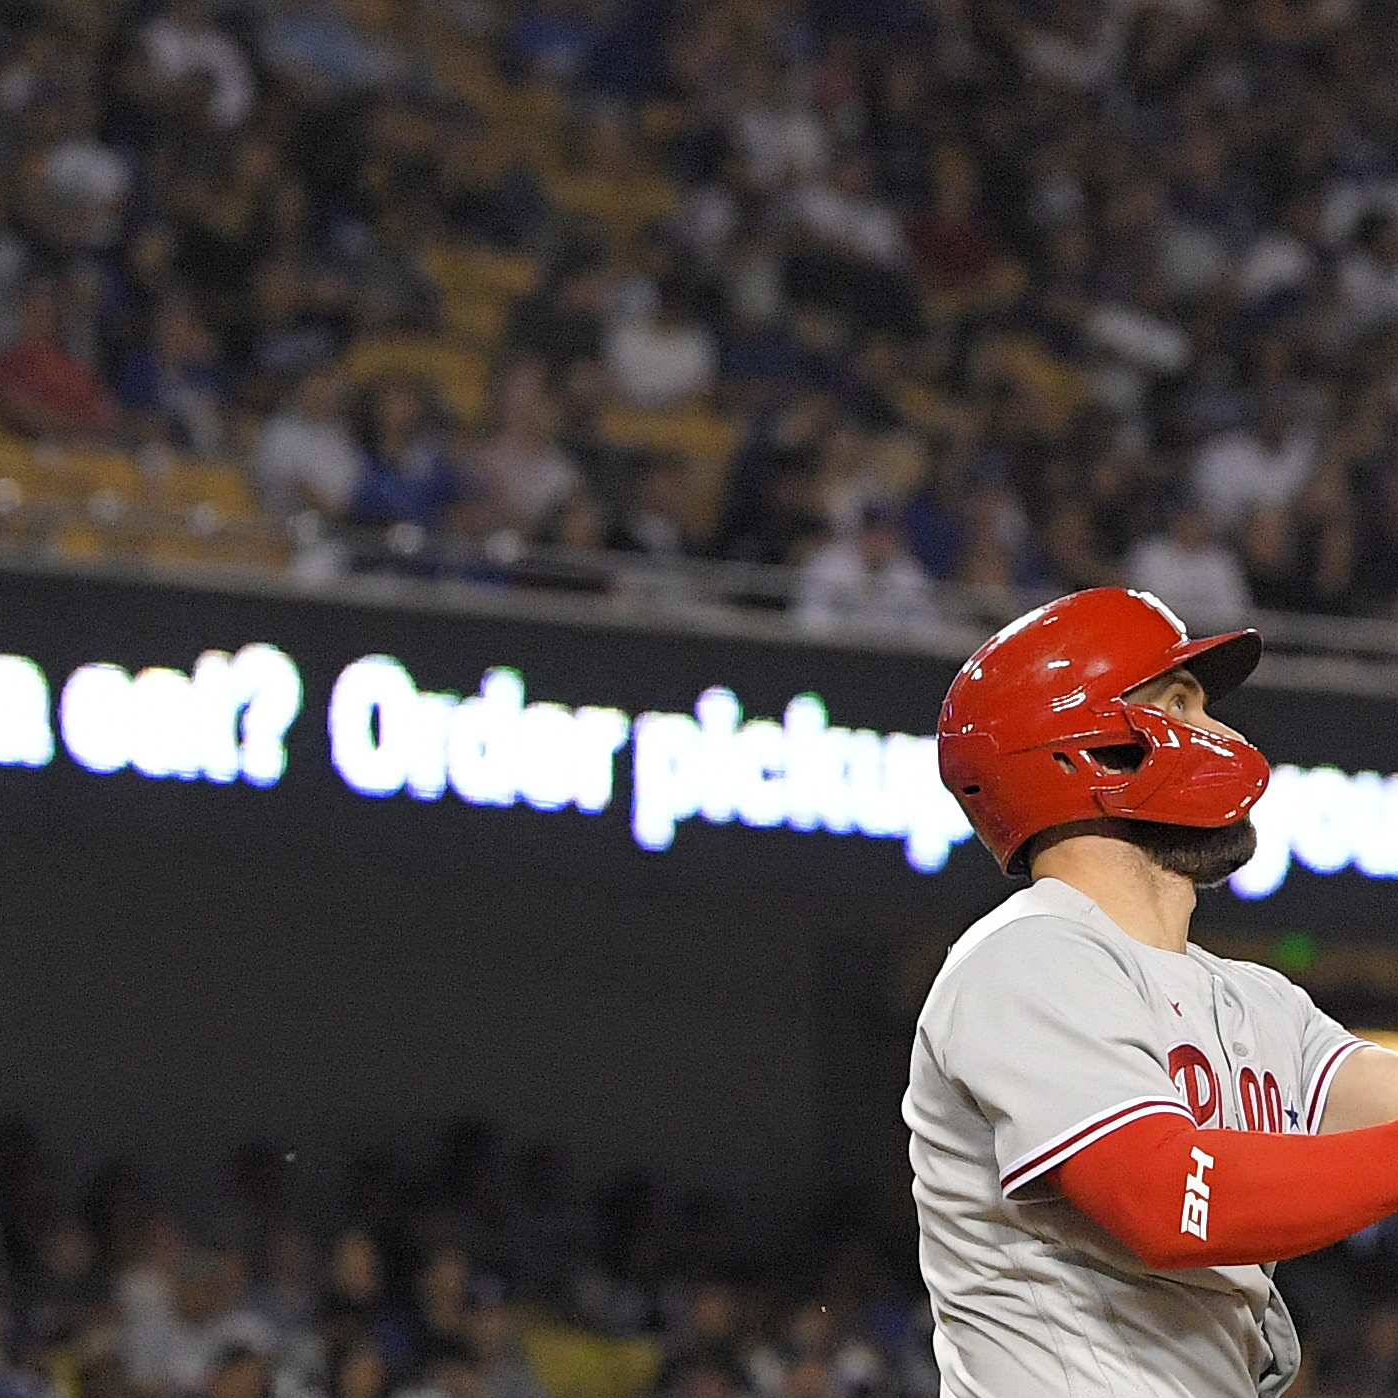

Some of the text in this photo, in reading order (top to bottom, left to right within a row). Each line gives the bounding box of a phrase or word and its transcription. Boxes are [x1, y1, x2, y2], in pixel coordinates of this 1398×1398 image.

[60, 642, 303, 789] eat?
[327, 653, 632, 817] Order
[1180, 1146, 1214, 1241] BH
